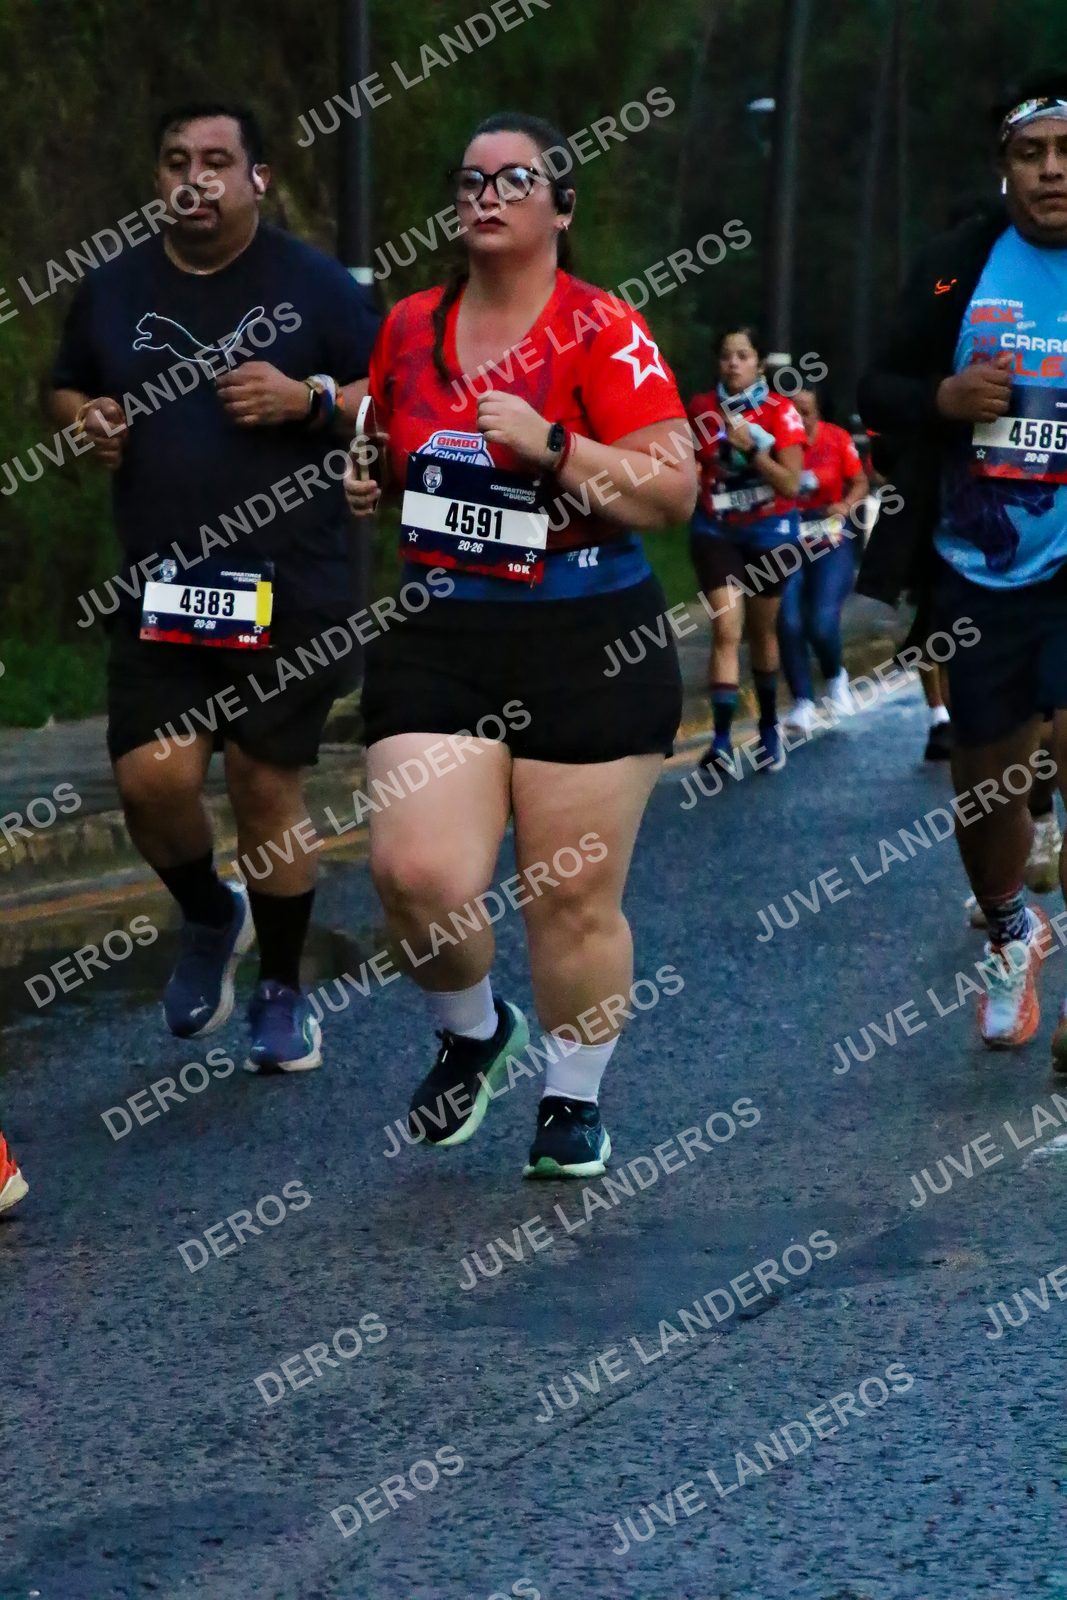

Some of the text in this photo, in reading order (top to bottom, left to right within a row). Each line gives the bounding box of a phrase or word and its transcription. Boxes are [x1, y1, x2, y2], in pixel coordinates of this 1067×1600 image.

[1008, 420, 1067, 450] 4585
[437, 437, 479, 449] BIMBO
[490, 484, 536, 497] COMPARTIMOS
[445, 502, 503, 540] 4591
[457, 539, 484, 554] 20-26
[507, 562, 531, 575] 10K
[180, 588, 235, 617] 4383
[238, 635, 258, 644] 10K
